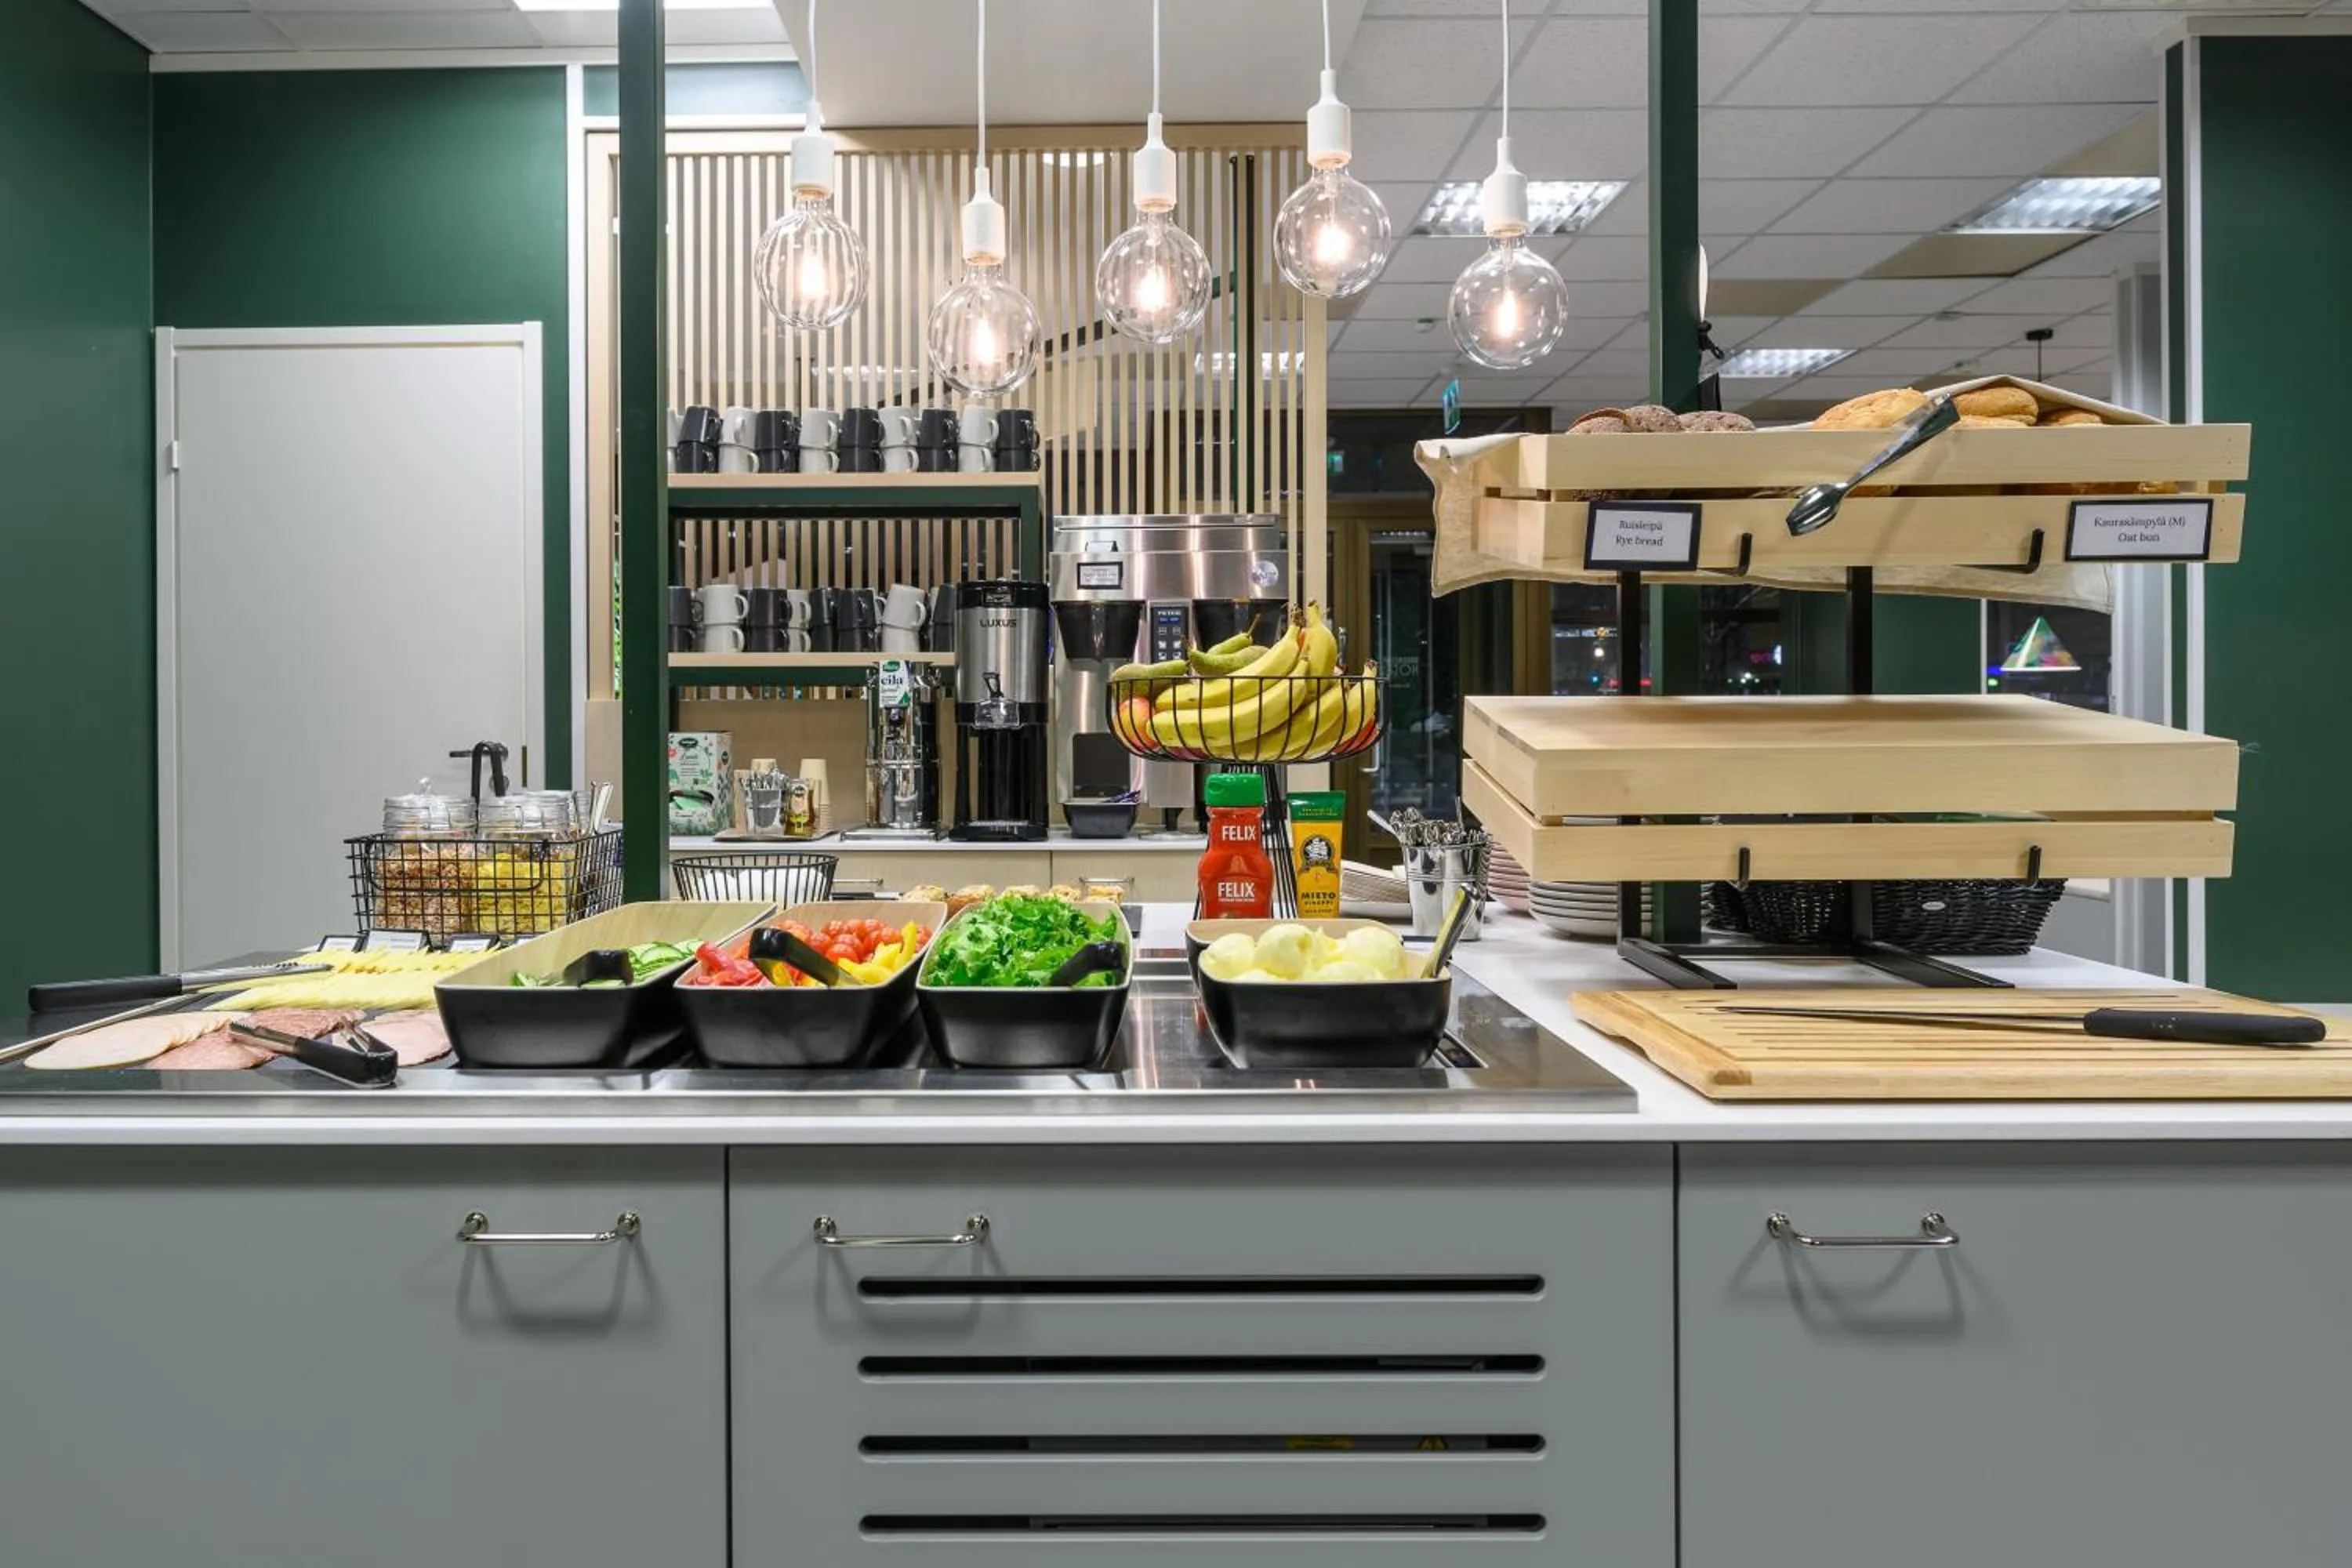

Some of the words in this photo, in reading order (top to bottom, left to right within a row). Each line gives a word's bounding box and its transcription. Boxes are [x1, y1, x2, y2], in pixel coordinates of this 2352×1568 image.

[2169, 516, 2185, 528] (M)
[1616, 535, 1633, 547] Rye
[1635, 535, 1663, 546] bread
[2118, 532, 2137, 543] Oat
[2140, 532, 2160, 543] bun
[979, 619, 1017, 628] LUXUS
[1221, 826, 1256, 841] FELIX
[1218, 882, 1255, 898] FELIX
[1301, 891, 1336, 900] MIETO
